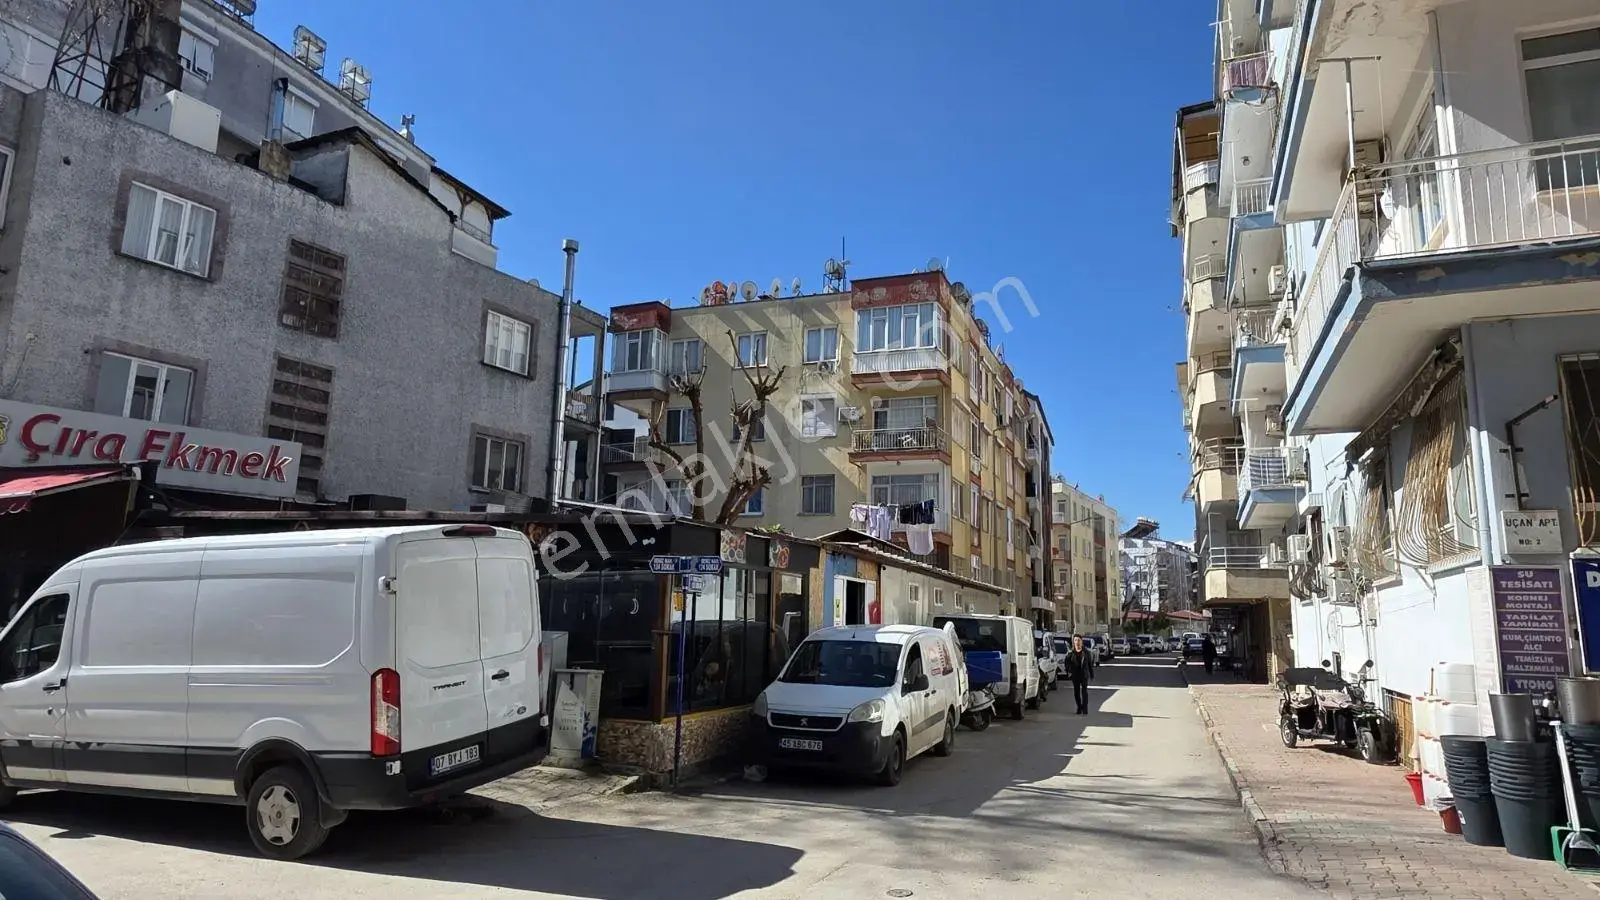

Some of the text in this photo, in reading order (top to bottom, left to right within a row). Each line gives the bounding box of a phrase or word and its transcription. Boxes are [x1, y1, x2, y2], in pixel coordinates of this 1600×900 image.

[19, 413, 292, 483] Çıra Ekmek
[1505, 518, 1533, 528] UÇAN
[1517, 570, 1534, 578] SU
[1500, 579, 1553, 589] TESİSATI
[1505, 613, 1555, 621] TADİLAT
[1523, 643, 1543, 651] ALÇI
[1514, 679, 1555, 690] YTONG
[435, 756, 445, 769] 07
[447, 751, 462, 765] BYJ
